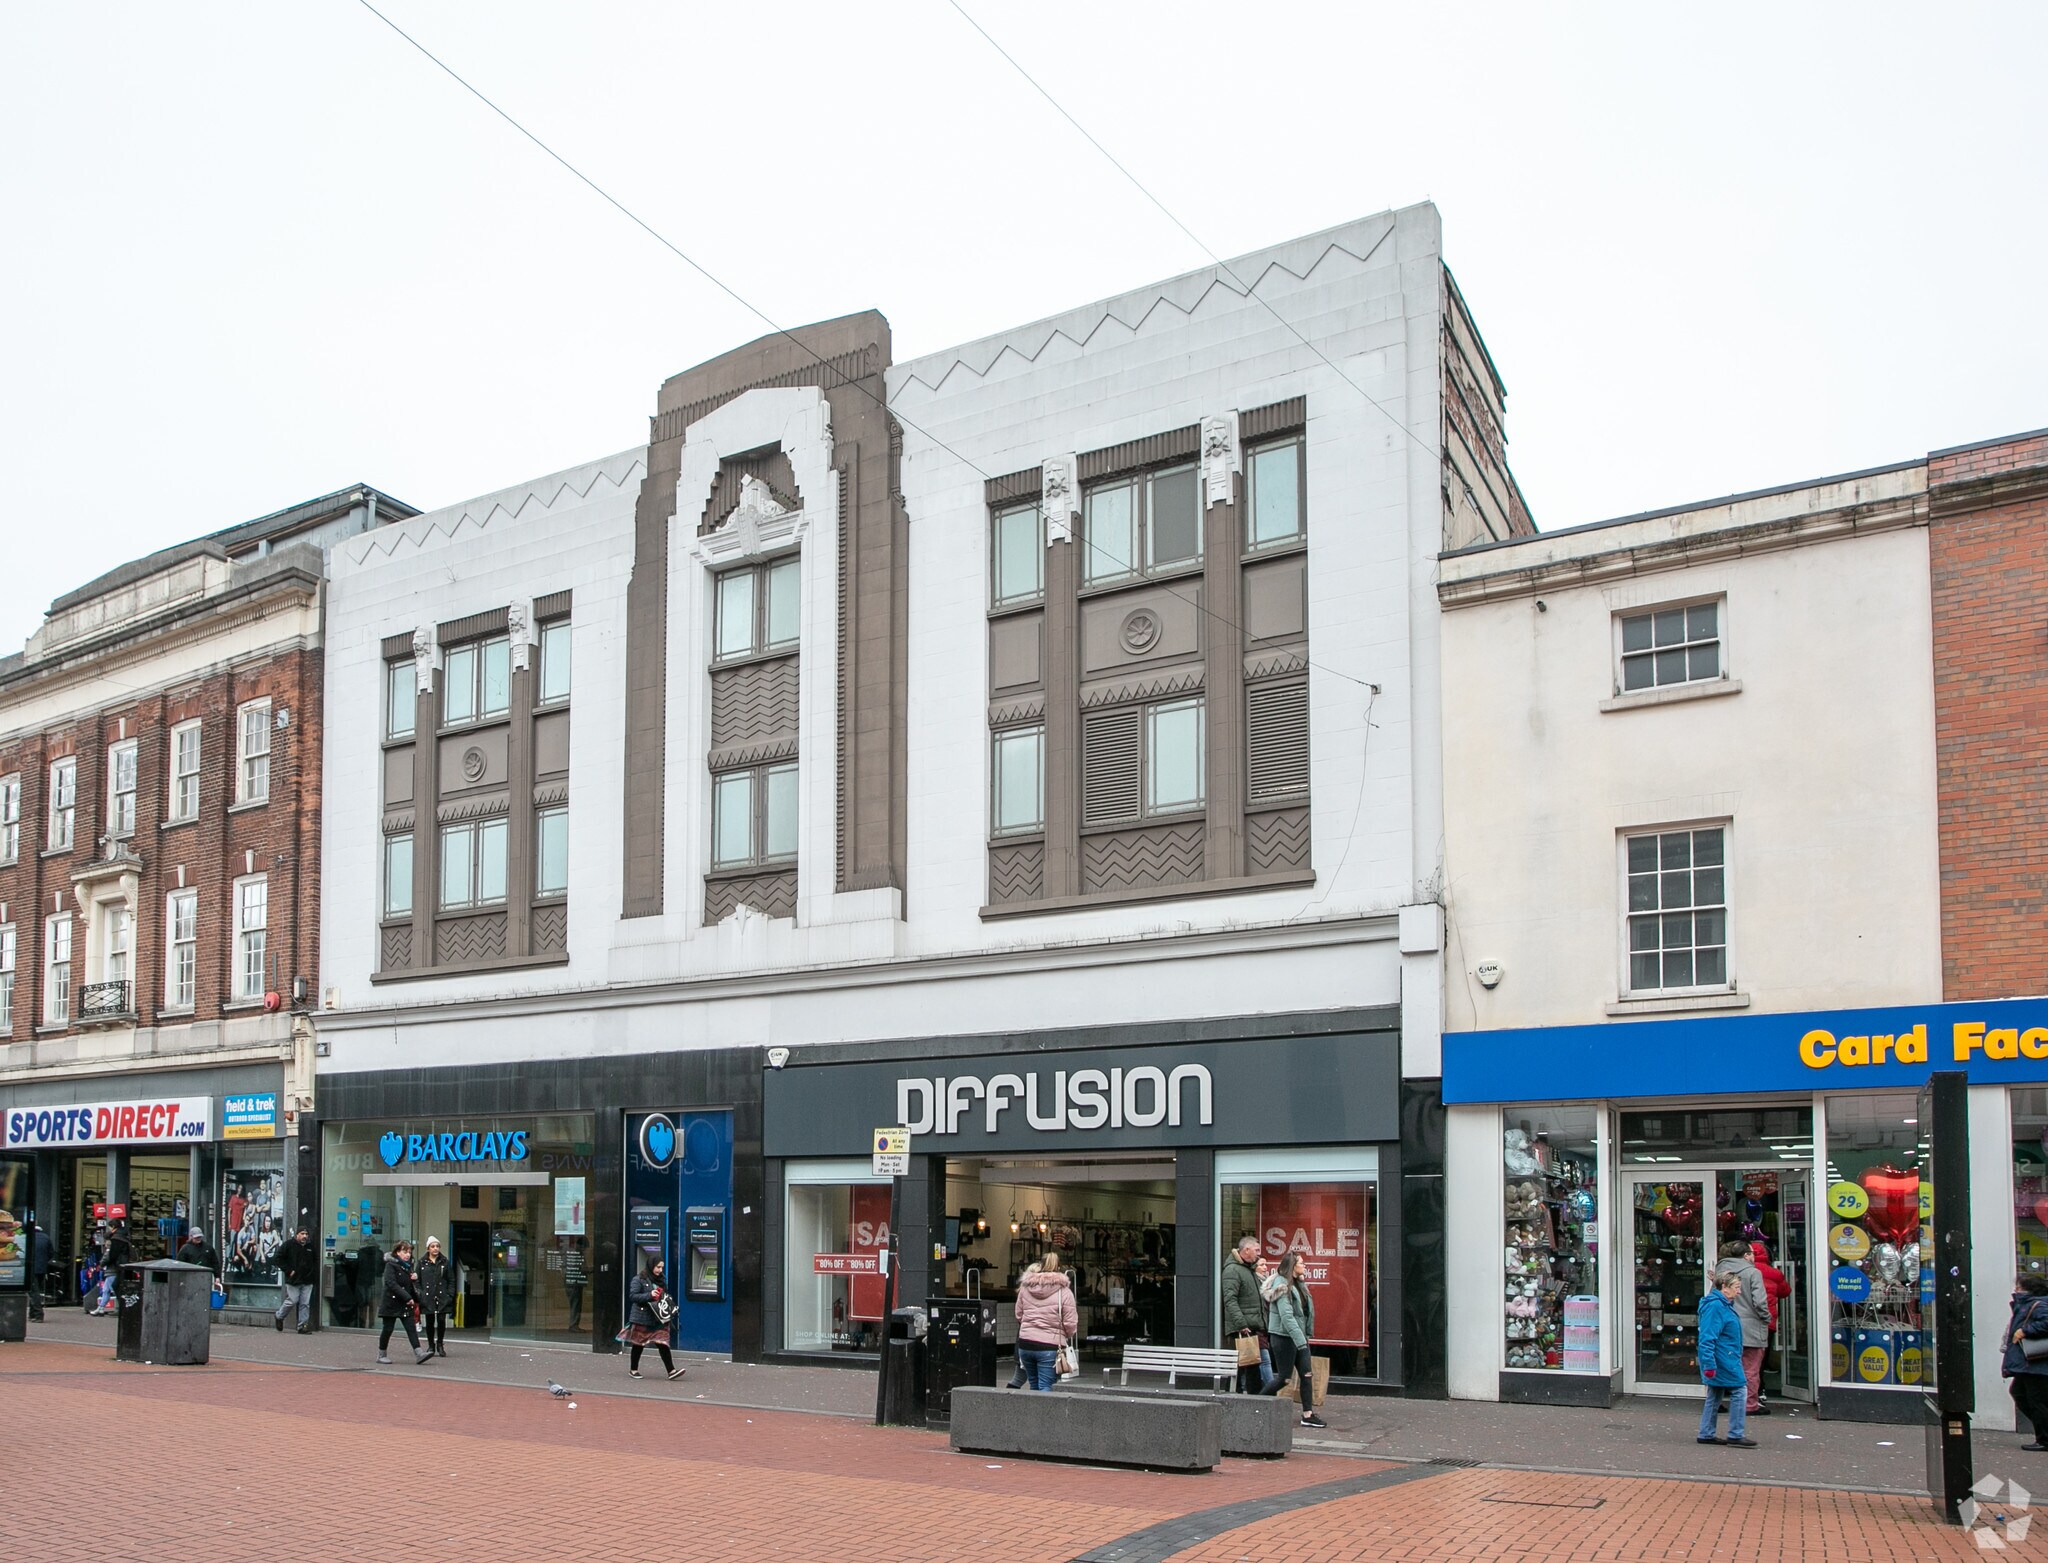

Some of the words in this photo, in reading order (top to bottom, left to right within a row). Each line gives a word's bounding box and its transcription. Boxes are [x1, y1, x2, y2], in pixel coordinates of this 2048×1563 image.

[1799, 1024, 1928, 1068] Card
[226, 1099, 246, 1112] field
[247, 1098, 254, 1111] &
[256, 1097, 275, 1111] trek
[897, 1063, 1213, 1135] DIFFUSION
[9, 1108, 93, 1143] SPORTS
[407, 1131, 528, 1162] BARCLAYS
[1837, 1196, 1862, 1209] 29p
[857, 1221, 889, 1246] SA
[1265, 1227, 1360, 1257] SALE
[820, 1259, 833, 1268] 80%
[834, 1260, 844, 1268] OFF
[851, 1260, 864, 1268] 80%
[865, 1260, 876, 1269] OFF
[1313, 1269, 1327, 1279] OFF
[1863, 1357, 1884, 1365] GREAT
[1863, 1364, 1884, 1372] VALUE
